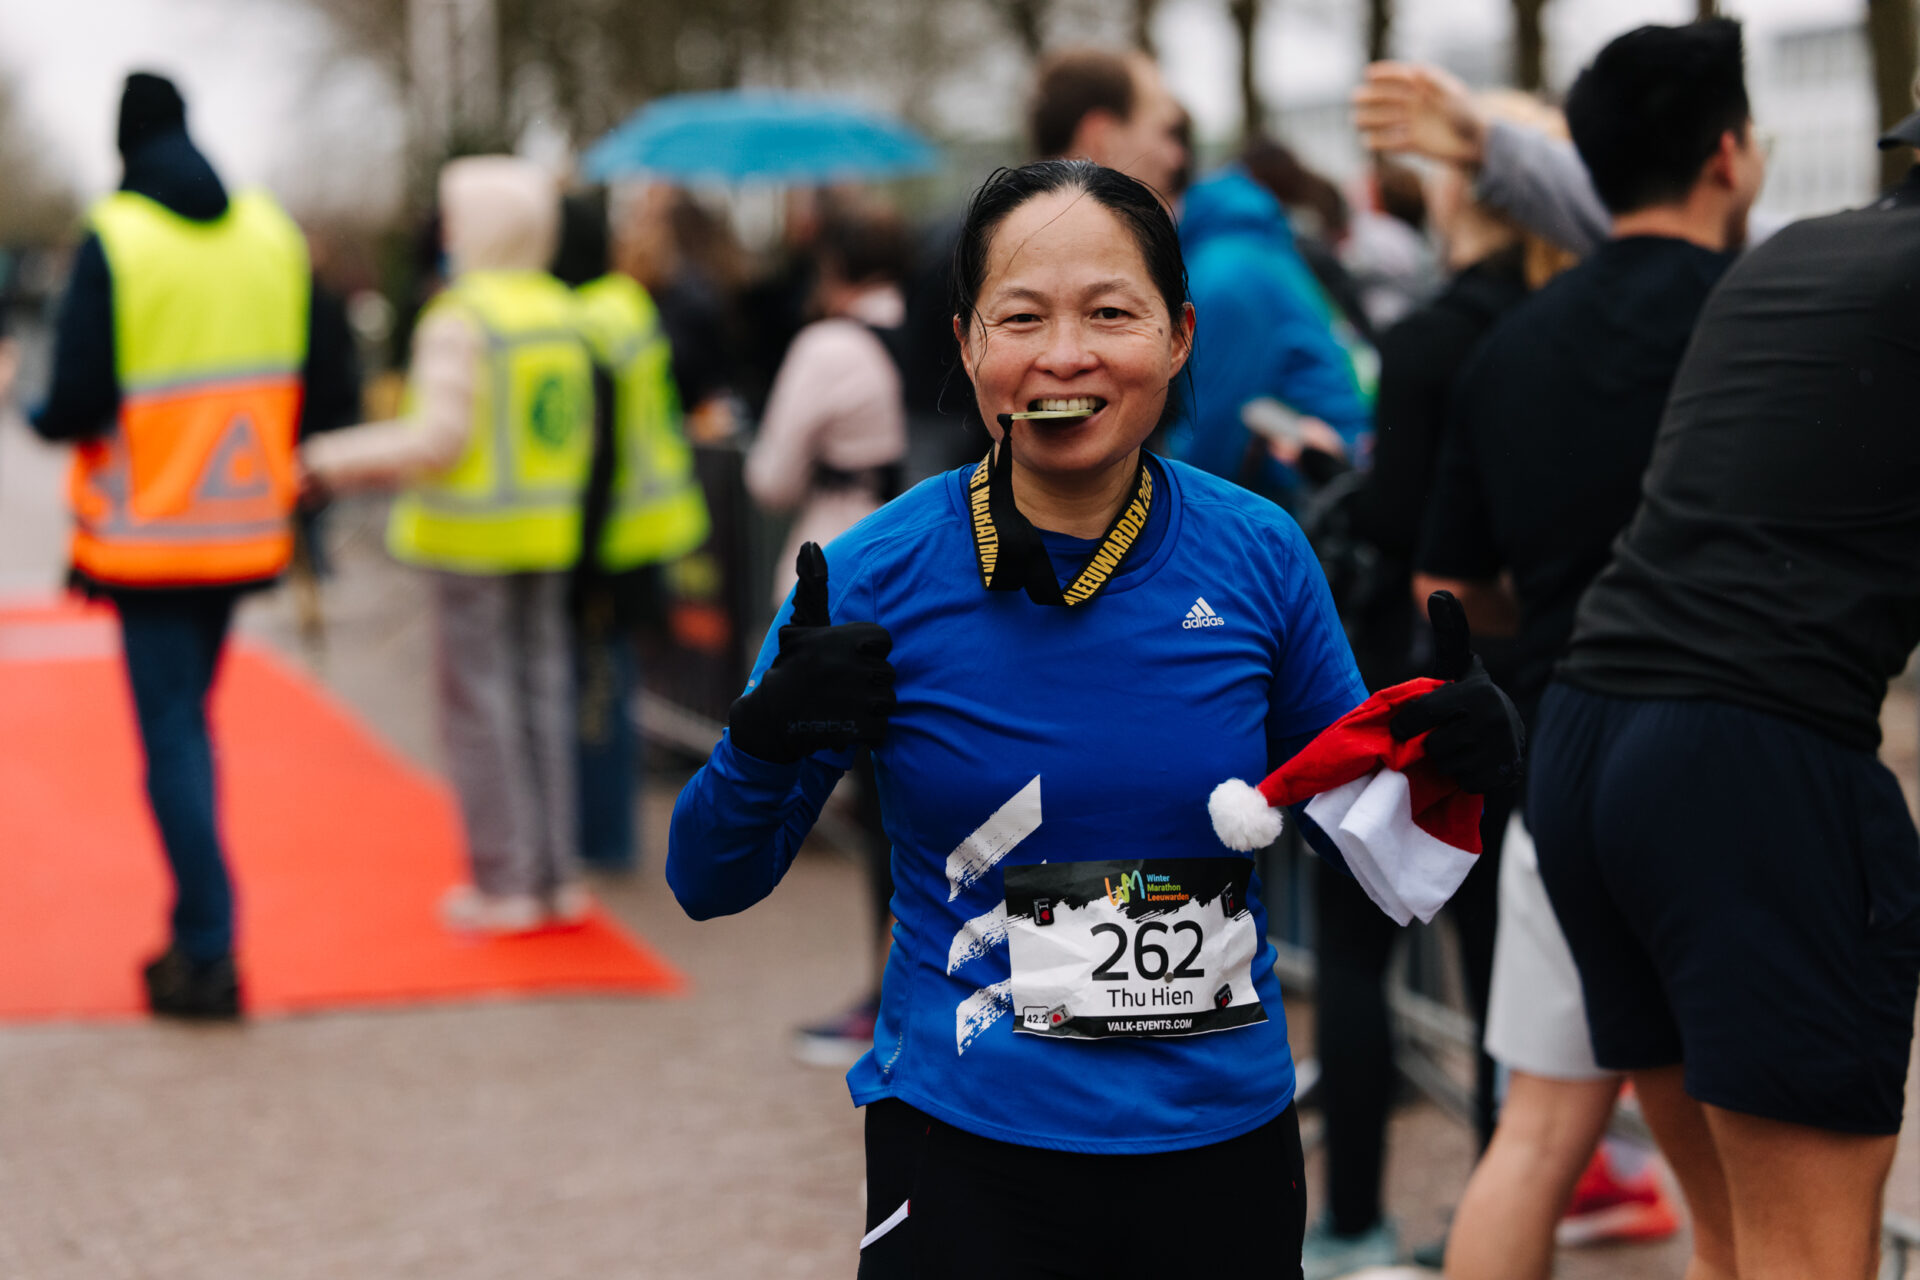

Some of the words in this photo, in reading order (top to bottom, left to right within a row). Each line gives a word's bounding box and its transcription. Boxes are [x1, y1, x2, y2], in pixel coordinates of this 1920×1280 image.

[1067, 499, 1147, 600] LEEUWARDEN
[1182, 616, 1224, 629] adidas
[1146, 874, 1170, 882] Winter
[1147, 883, 1181, 892] Marathon
[1147, 893, 1189, 901] Leeuwarden
[1090, 920, 1204, 981] 262
[1107, 988, 1145, 1007] Thu
[1152, 986, 1193, 1006] Hien
[1026, 1014, 1048, 1024] 42.2
[1107, 1019, 1192, 1031] VALK-EVENTS.COM
